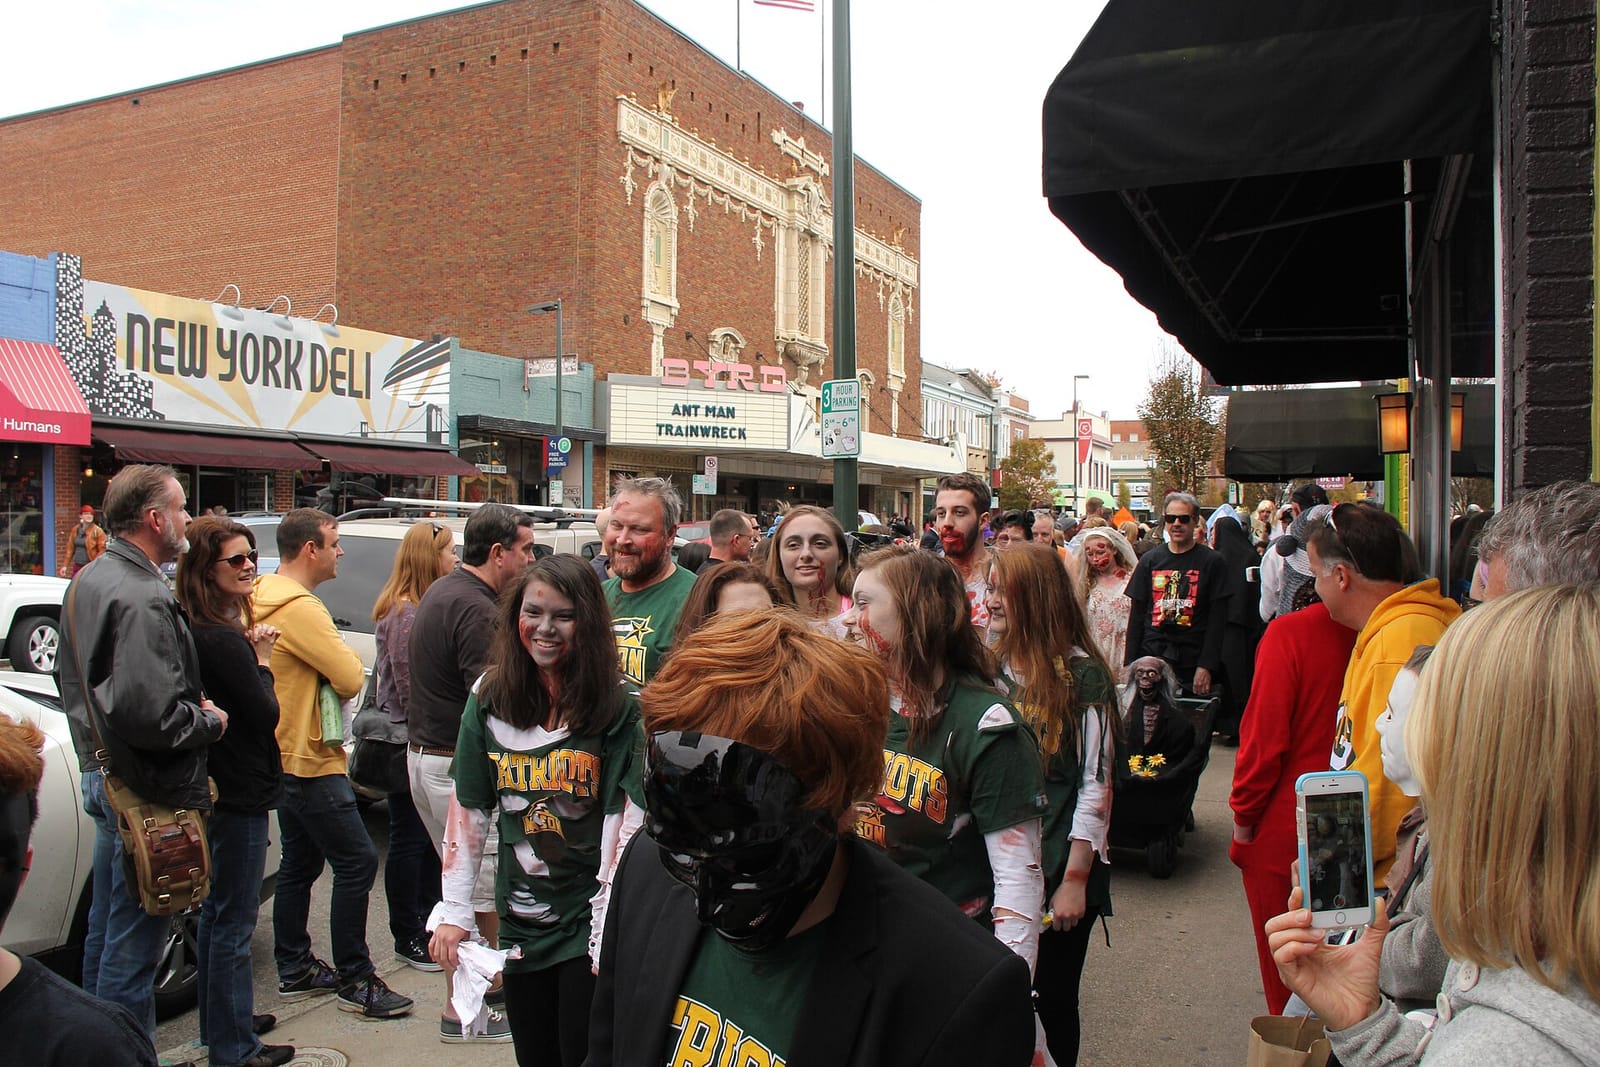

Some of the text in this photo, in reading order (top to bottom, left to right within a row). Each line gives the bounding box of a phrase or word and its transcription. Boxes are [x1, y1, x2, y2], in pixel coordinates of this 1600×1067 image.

[126, 312, 371, 400] NEW YORK DELI
[661, 357, 787, 392] BYRD
[824, 389, 830, 407] 3
[836, 385, 853, 395] HOUR
[832, 396, 857, 408] PARKING
[671, 403, 736, 420] ANT MAN
[3, 417, 62, 434] Humans
[656, 422, 747, 440] TRAINWRECK
